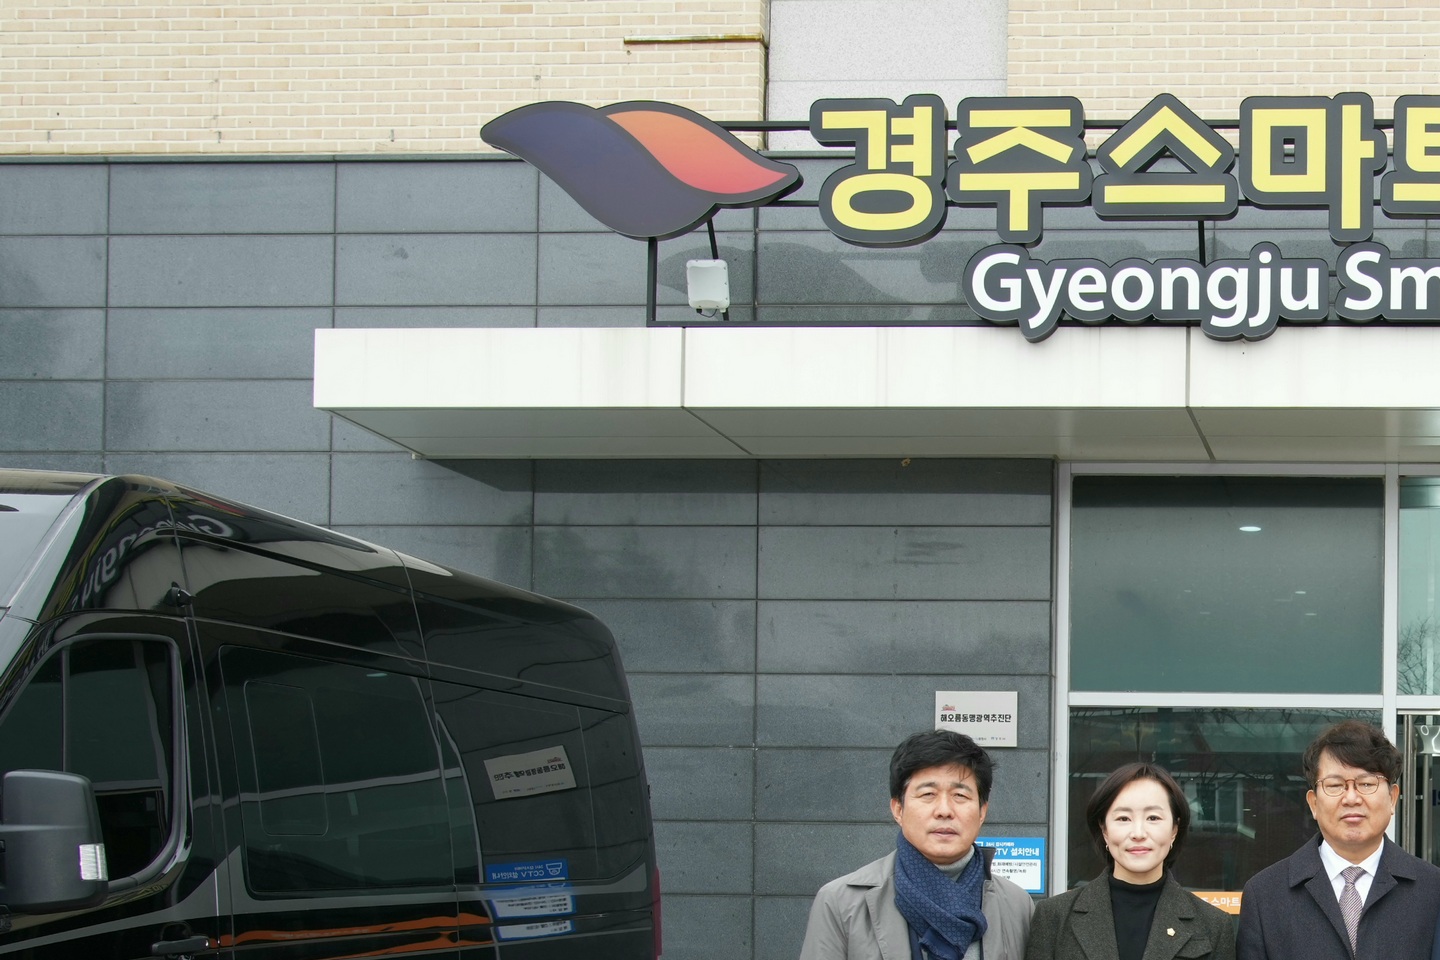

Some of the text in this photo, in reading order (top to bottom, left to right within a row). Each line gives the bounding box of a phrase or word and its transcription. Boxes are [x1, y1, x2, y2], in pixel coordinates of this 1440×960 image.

[970, 249, 1321, 330] Gyeongju
[940, 713, 1012, 723] 해오름동맹광역추진단
[1010, 847, 1040, 857] 설치안내
